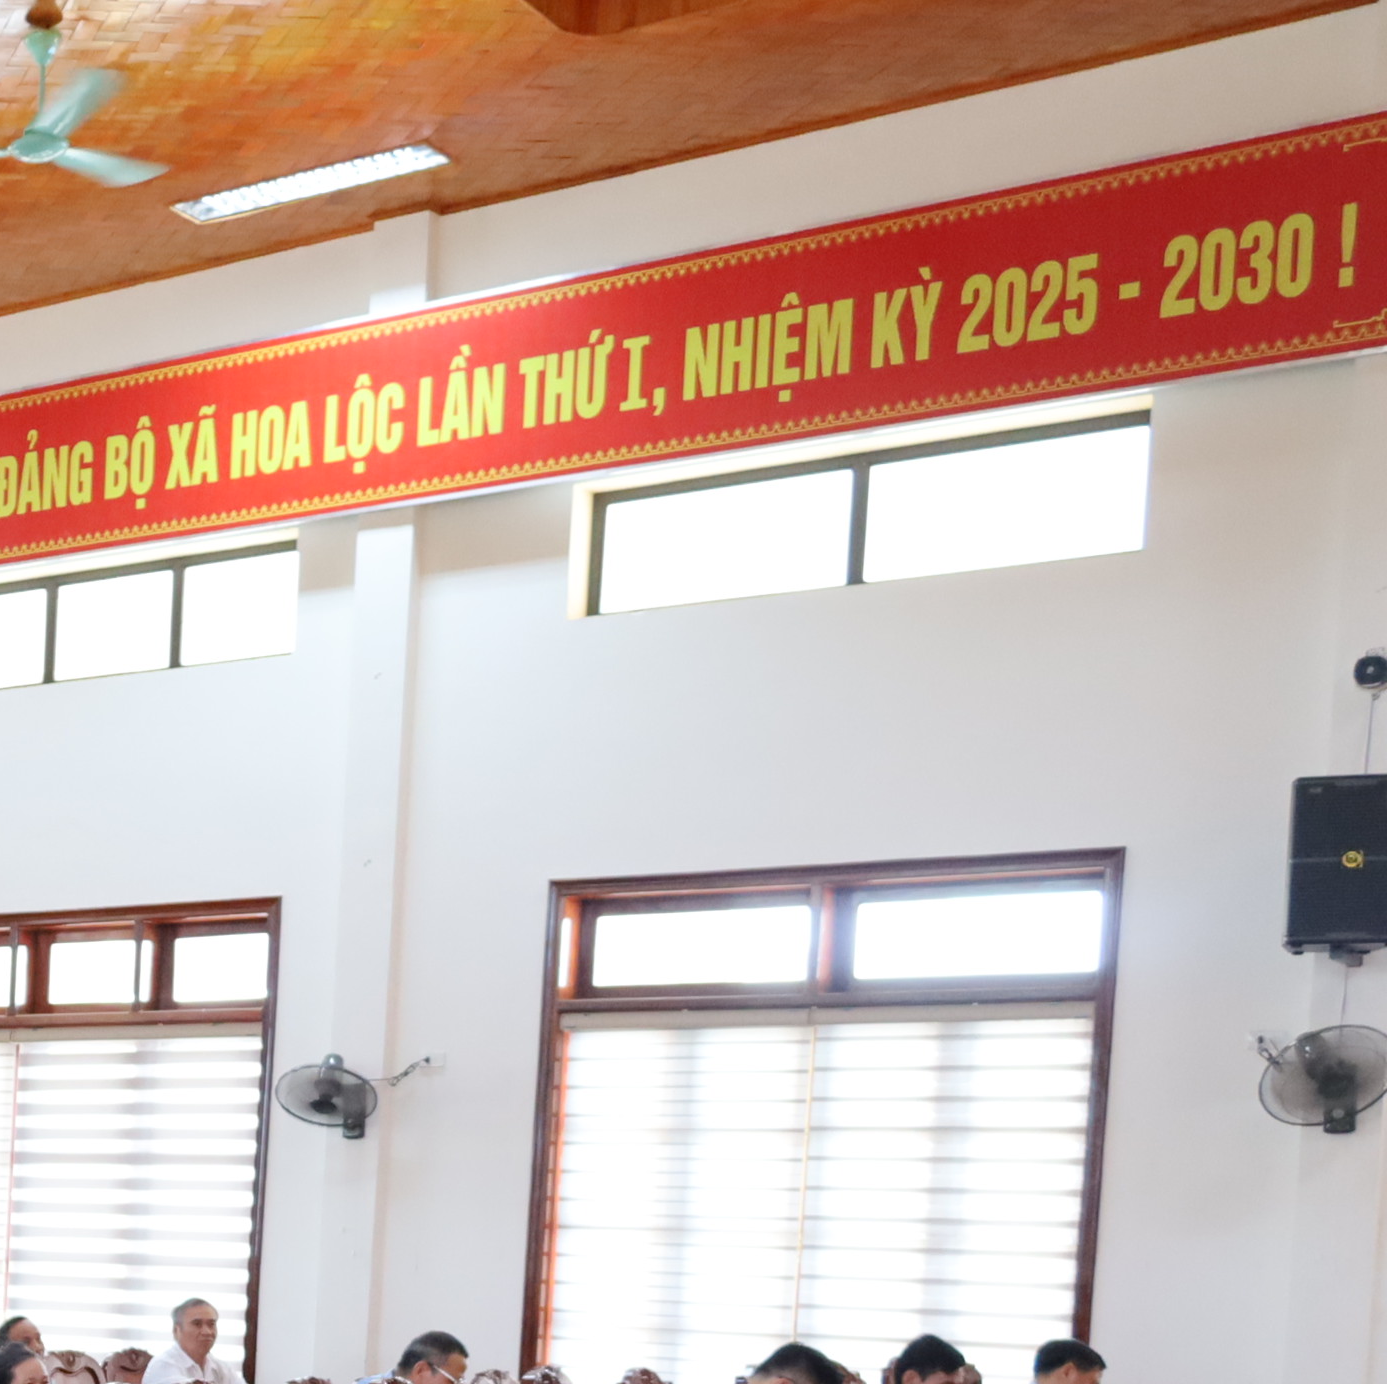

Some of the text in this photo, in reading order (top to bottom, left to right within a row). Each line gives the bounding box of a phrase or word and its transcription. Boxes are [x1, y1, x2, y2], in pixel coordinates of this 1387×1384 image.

[104, 415, 156, 510] BỘ
[165, 404, 220, 490] XÃ
[230, 400, 313, 480] HOA
[323, 373, 406, 474] LỘC
[416, 344, 507, 447] LẦN
[519, 328, 615, 429] THỨ
[619, 335, 667, 416] I,
[682, 293, 854, 403] NHIỆM
[870, 267, 942, 369] KỲ
[957, 253, 1098, 353] 2025
[1160, 213, 1314, 318] 2030
[1339, 203, 1358, 287] !
